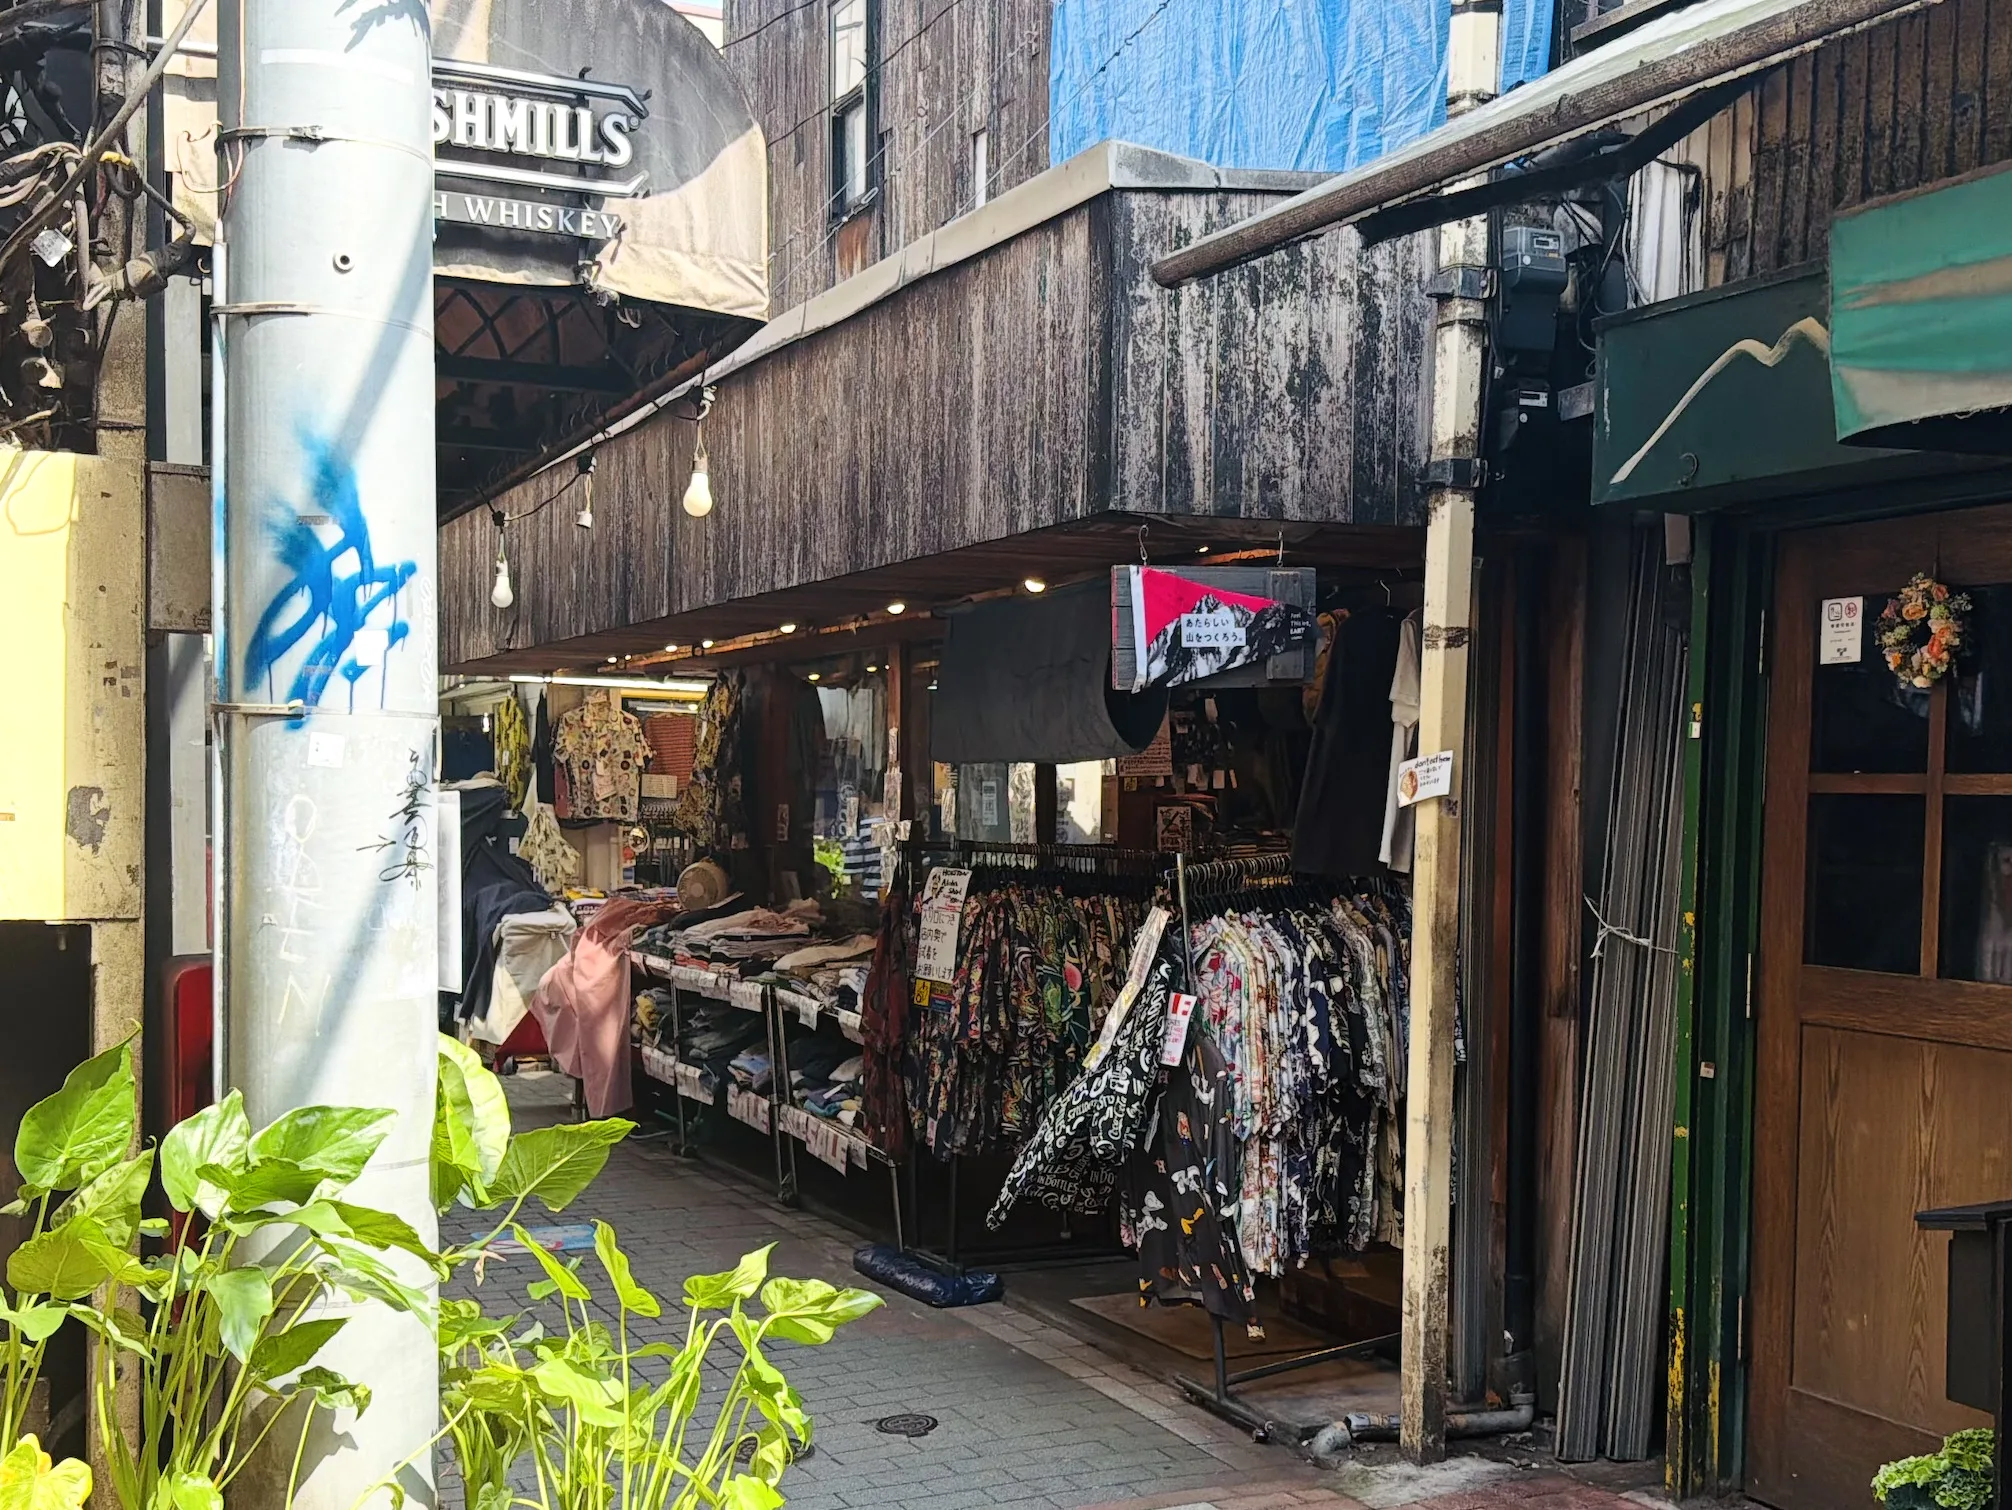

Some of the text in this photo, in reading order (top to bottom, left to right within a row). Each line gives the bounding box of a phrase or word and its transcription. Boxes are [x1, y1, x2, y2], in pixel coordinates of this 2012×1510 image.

[464, 196, 621, 238] WHISKEY
[1186, 618, 1229, 628] あたらしい
[1186, 632, 1243, 642] 山をつくろう。
